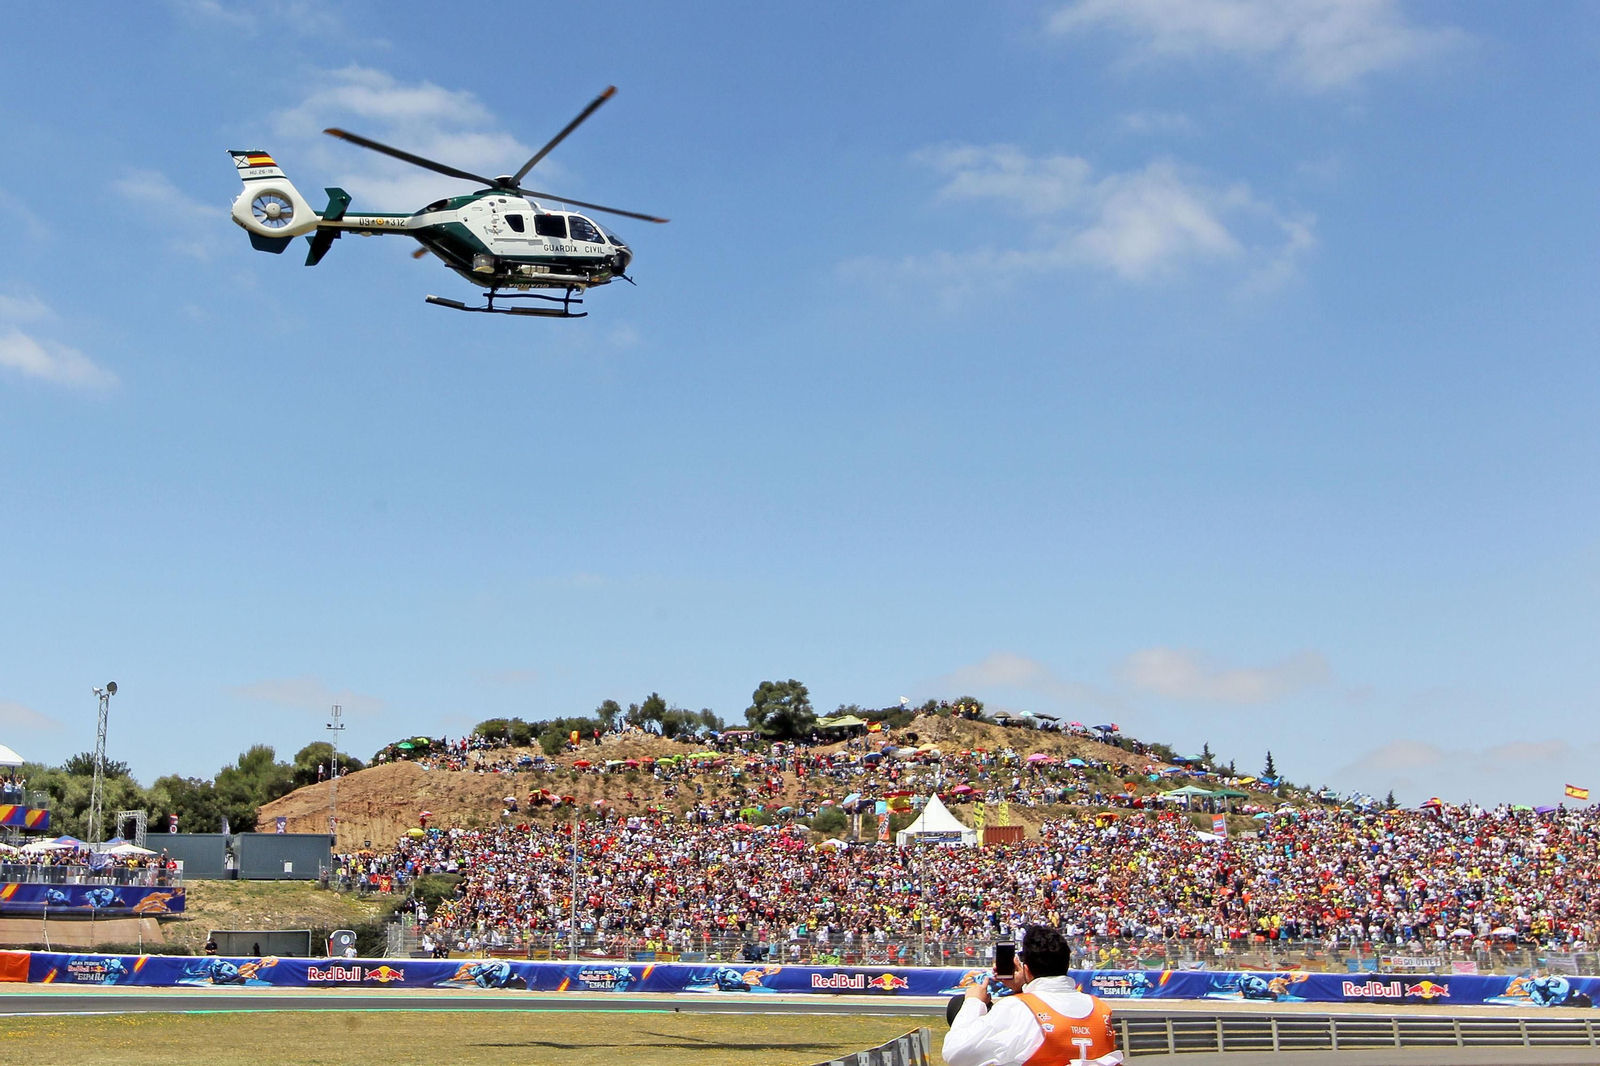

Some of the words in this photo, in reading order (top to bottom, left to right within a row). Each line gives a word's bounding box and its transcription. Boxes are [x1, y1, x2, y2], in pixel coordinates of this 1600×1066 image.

[359, 218, 370, 226] 09
[390, 218, 405, 227] 312
[544, 244, 578, 253] GUARDIA
[584, 246, 604, 254] CIVIL
[1070, 1026, 1090, 1034] TRACK
[1071, 1038, 1092, 1060] T
